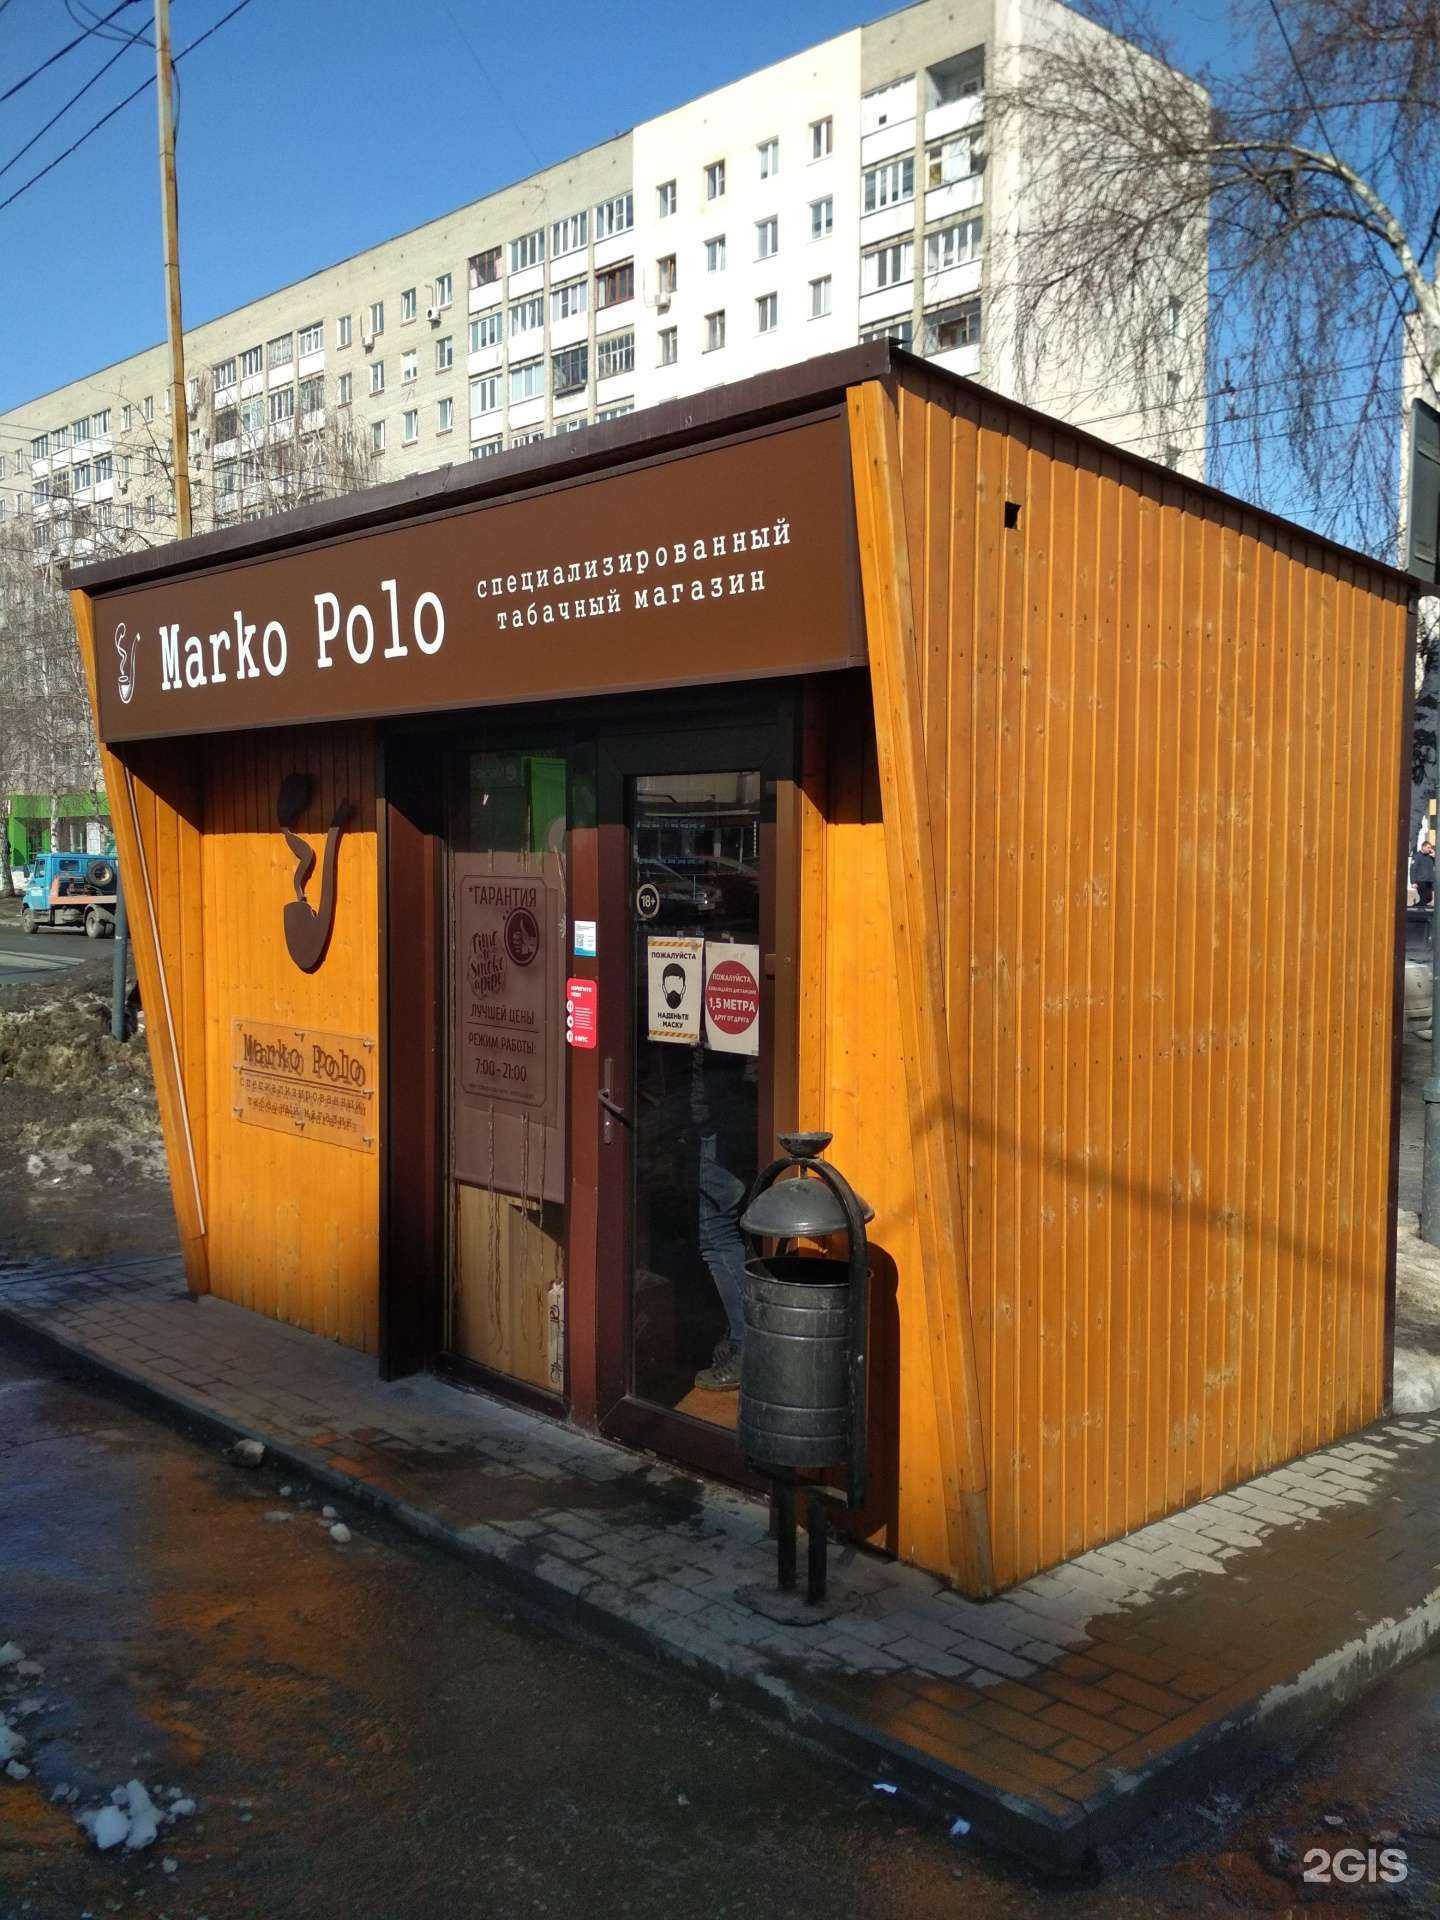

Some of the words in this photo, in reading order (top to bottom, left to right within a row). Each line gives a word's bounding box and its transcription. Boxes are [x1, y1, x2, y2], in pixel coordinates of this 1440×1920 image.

[477, 517, 791, 598] специализированный
[497, 588, 621, 630] табачный
[635, 567, 767, 610] магазин
[159, 610, 288, 691] Marko
[314, 579, 446, 668] Polo
[640, 894, 656, 908] 18+
[651, 951, 697, 961] ПОЖАЛУЙСТА
[471, 1003, 507, 1021] ЛУЧШЕЙ
[509, 1008, 535, 1025] ЦЕНЫ
[709, 997, 722, 1012] 1,5
[723, 999, 756, 1013] МЕТРА
[657, 1011, 689, 1021] НАДЕНЬТЕ
[662, 1020, 683, 1029] МАСКУ
[468, 1031, 499, 1049] РЕЖИМ
[243, 1033, 304, 1076] Marko
[312, 1044, 366, 1087] Polo
